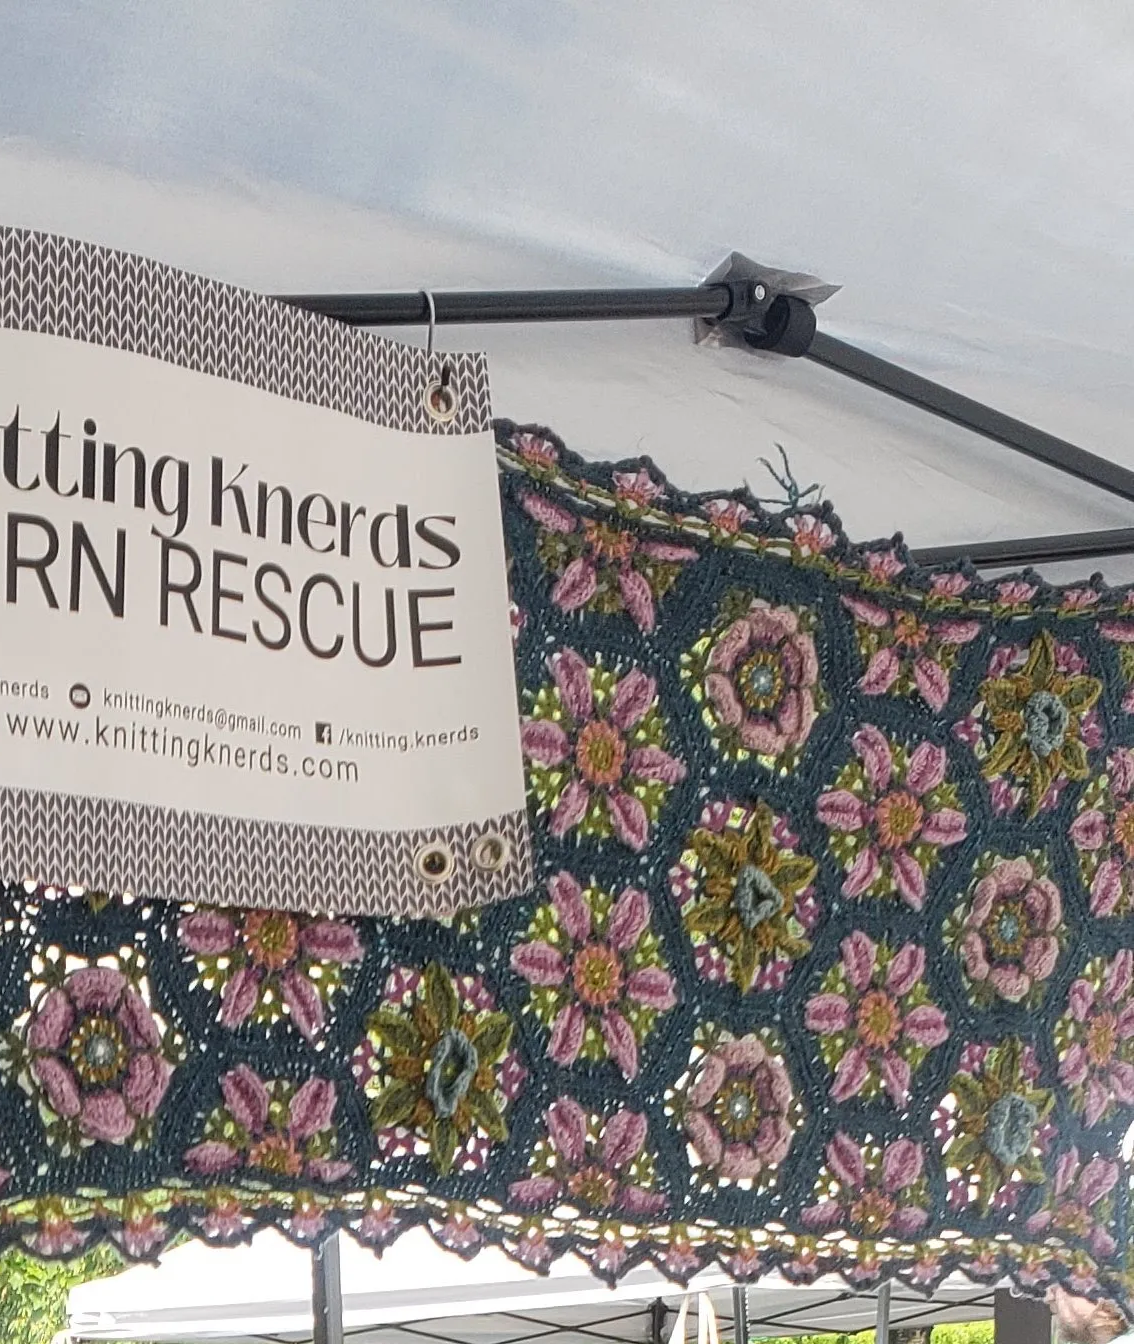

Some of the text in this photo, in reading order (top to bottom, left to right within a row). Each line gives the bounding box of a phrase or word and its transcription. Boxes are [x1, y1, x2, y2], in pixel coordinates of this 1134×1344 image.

[210, 455, 462, 570] Knerds
[158, 536, 463, 669] RESCUE
[5, 711, 360, 784] www.knittingknerds.com
[103, 687, 303, 741] knittingknerds@gmail.com
